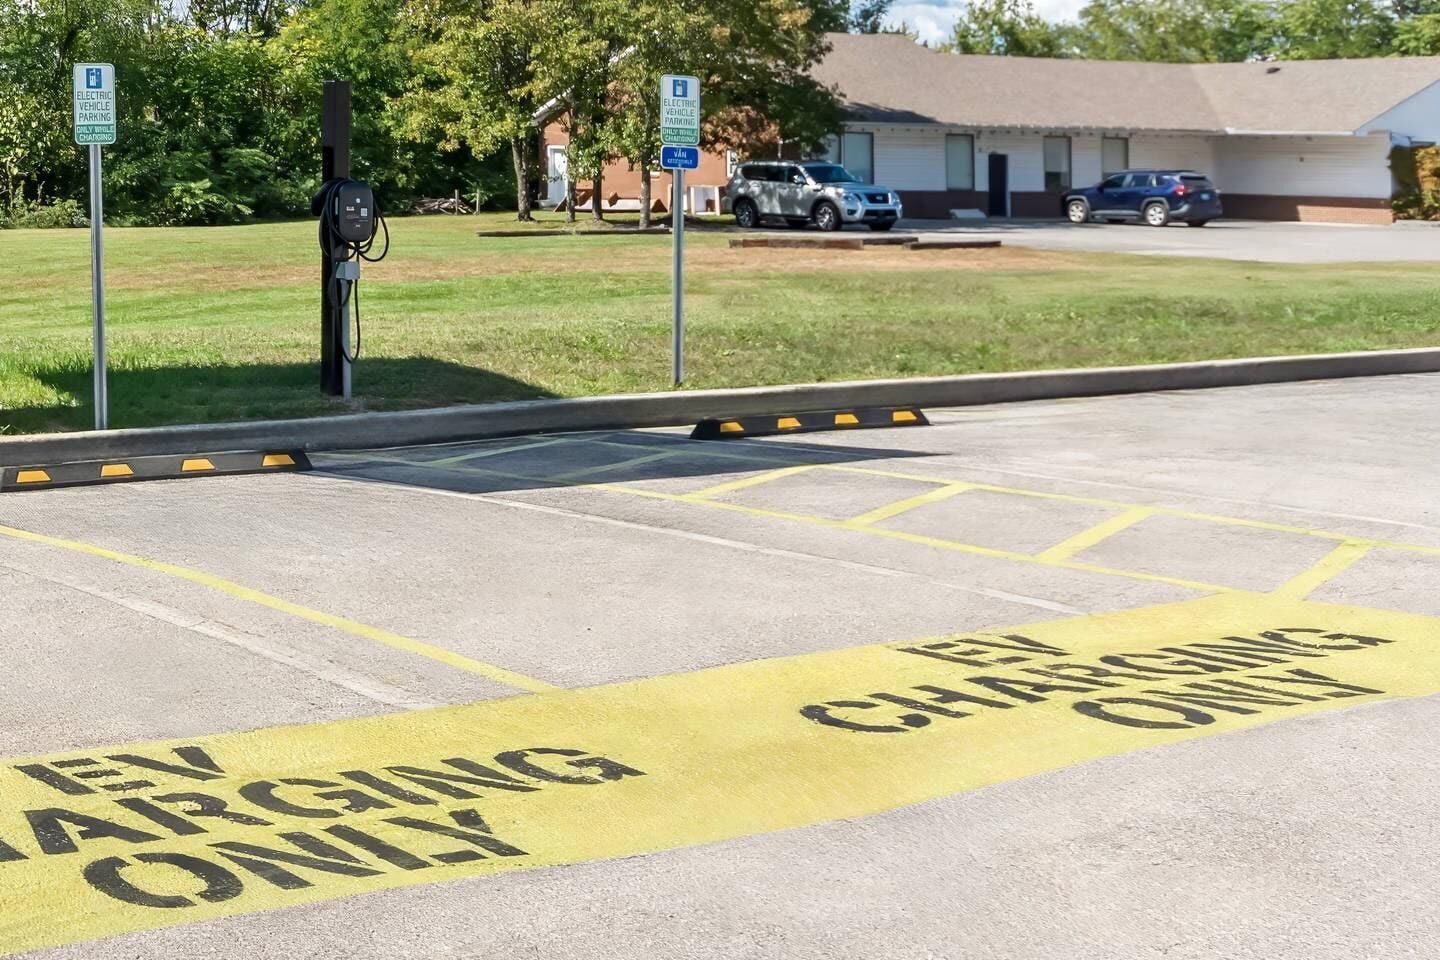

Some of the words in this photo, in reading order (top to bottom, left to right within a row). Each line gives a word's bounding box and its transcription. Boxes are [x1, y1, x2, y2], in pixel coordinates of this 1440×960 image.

[76, 90, 112, 100] ELECTRIC
[79, 101, 110, 111] VEHICLE
[663, 98, 696, 108] ELECTRIC
[78, 112, 112, 122] PARKING
[665, 107, 695, 117] VEHICLE
[664, 116, 695, 126] PARKING
[79, 133, 112, 141] CHARGING
[673, 151, 687, 159] VAN
[897, 632, 1073, 668] EV
[799, 627, 1397, 733] CHARGING
[1071, 668, 1387, 730] ONLY
[15, 745, 228, 796] EV
[82, 807, 531, 909] ONLY
